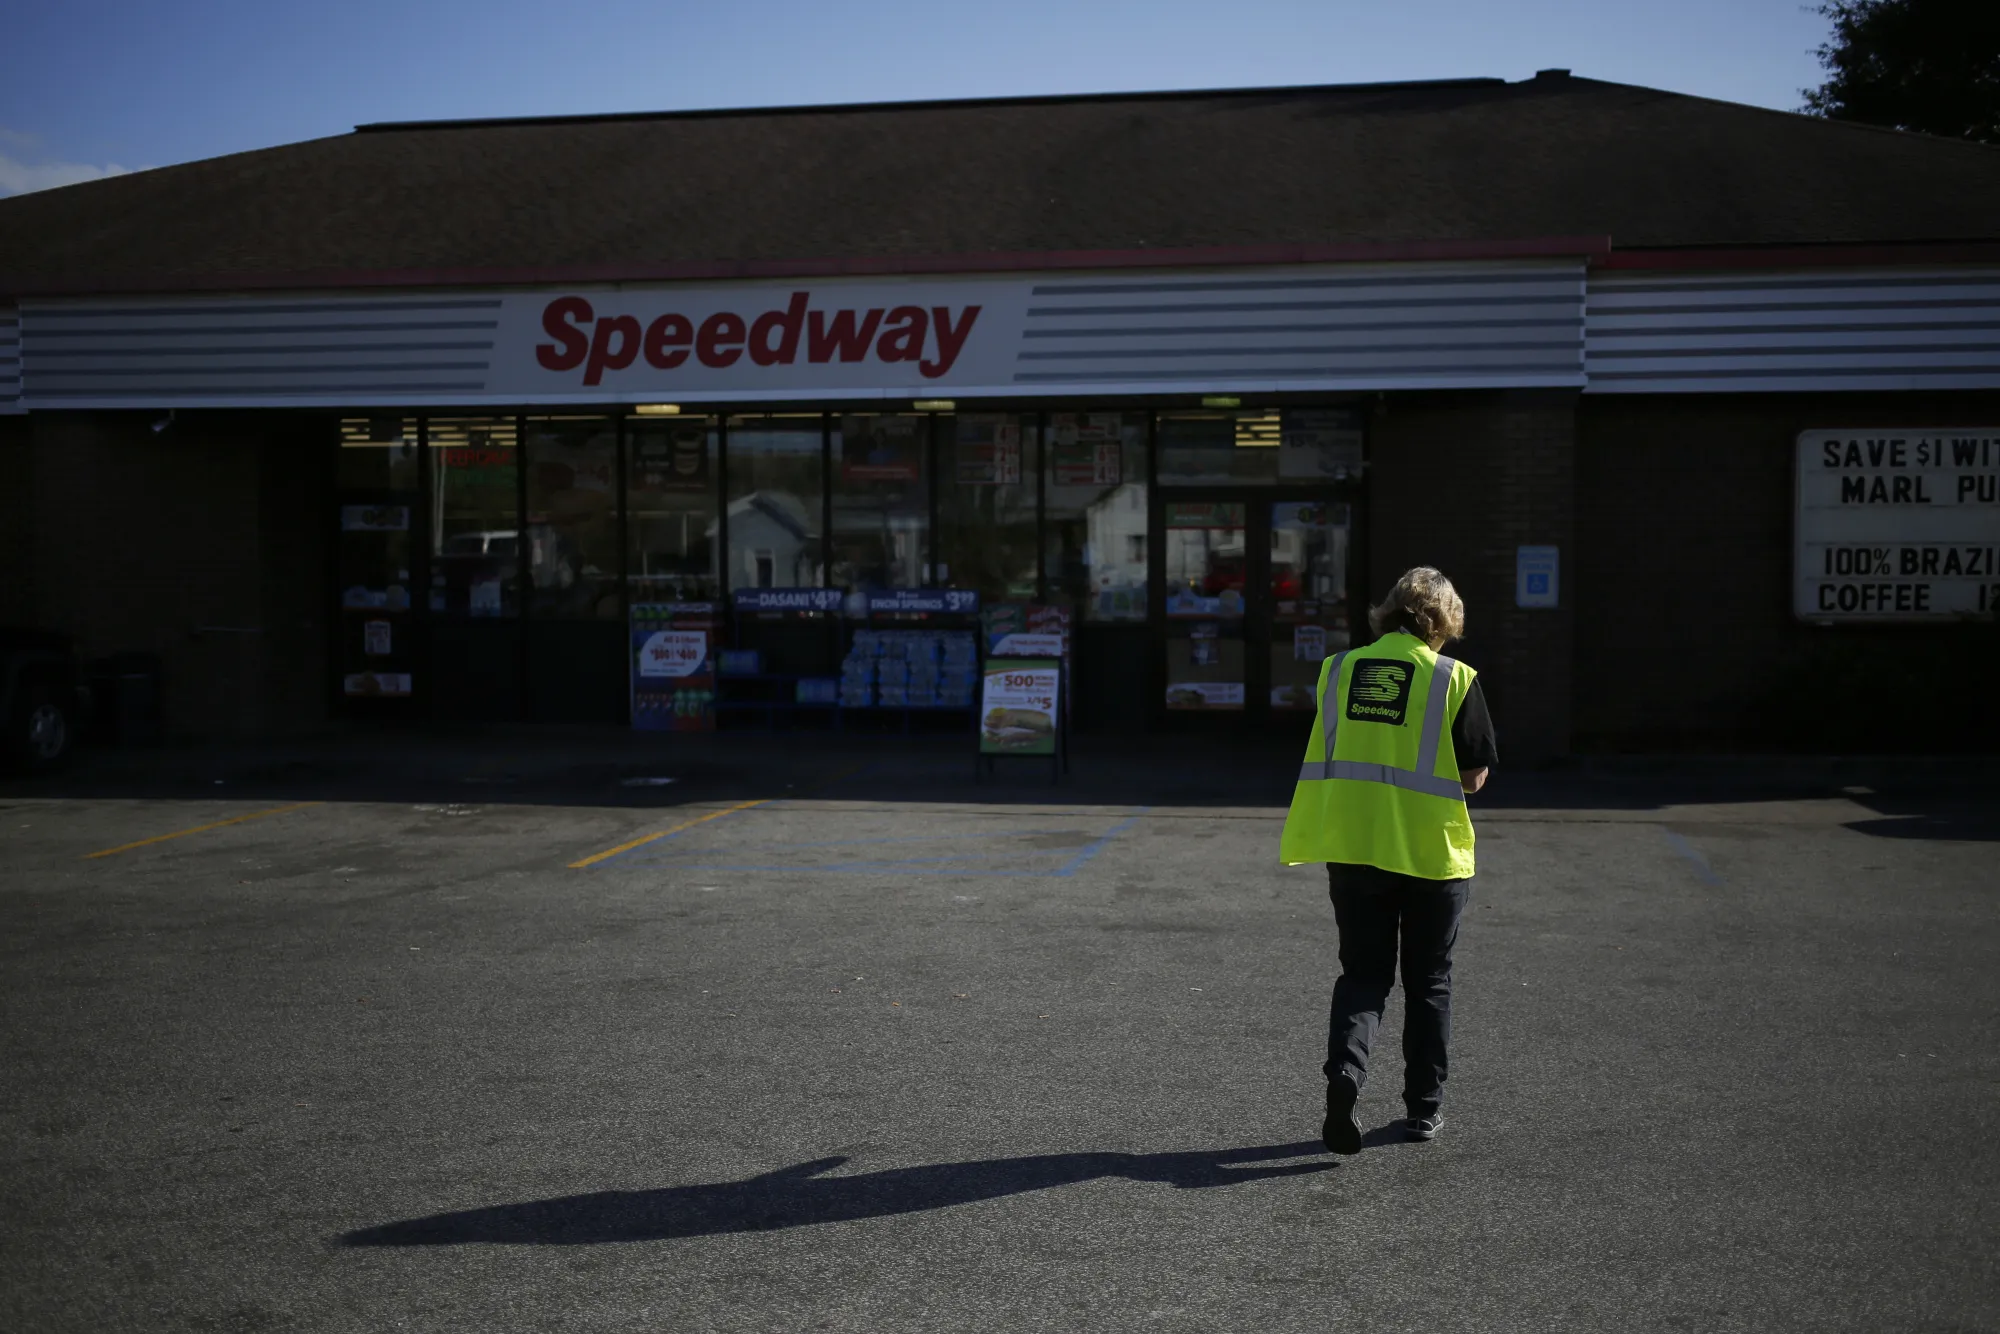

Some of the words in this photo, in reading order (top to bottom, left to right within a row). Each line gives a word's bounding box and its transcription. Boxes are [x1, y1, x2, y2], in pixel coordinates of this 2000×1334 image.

[536, 291, 983, 386] Speedway
[1823, 439, 1907, 468] SAVE
[1917, 438, 1942, 468] $1
[1841, 475, 1931, 503] MARL
[1958, 475, 2000, 503] PU
[1825, 547, 1891, 576] 100%
[1899, 547, 2000, 576] BRAZI
[759, 592, 810, 607] DASANI
[1818, 583, 1930, 612] COFFEE
[1004, 675, 1034, 687] 500
[1351, 703, 1401, 720] Speedway
